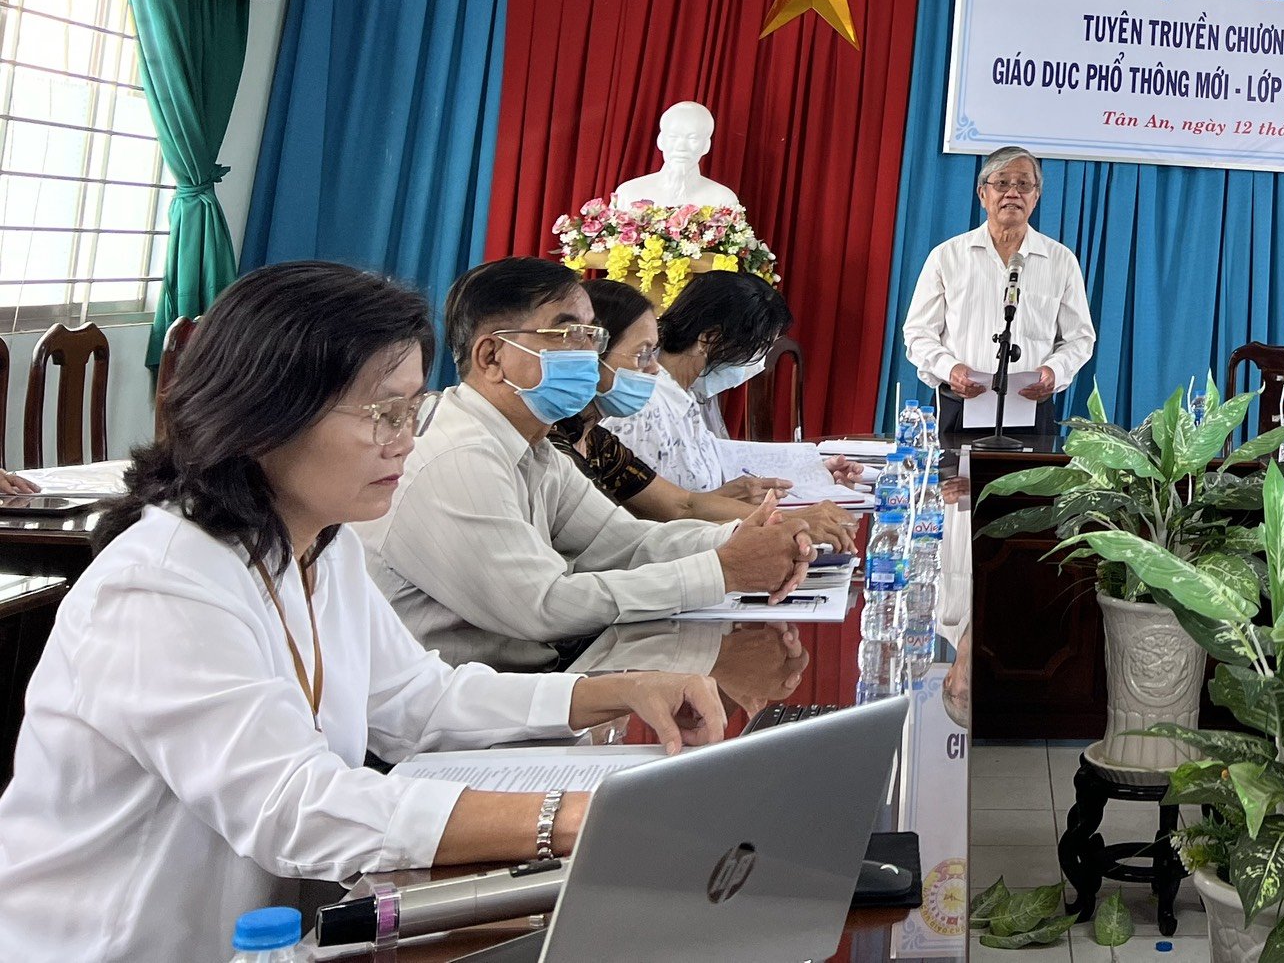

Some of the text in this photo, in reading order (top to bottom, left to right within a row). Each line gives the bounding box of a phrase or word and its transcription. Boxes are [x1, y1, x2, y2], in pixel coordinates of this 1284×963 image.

[1084, 10, 1142, 45] TUYÊN
[1149, 12, 1219, 51] TRUYỀN
[993, 52, 1036, 86] GIÁO
[1042, 61, 1079, 94] DỤC
[1086, 52, 1125, 92] PHỔ
[1129, 62, 1189, 97] THÔNG
[1195, 66, 1229, 100] MỚI
[1247, 69, 1282, 102] LỚP
[1103, 111, 1138, 127] Tân
[1144, 114, 1175, 132] An,
[1182, 118, 1226, 136] ngày
[1234, 121, 1252, 134] 12
